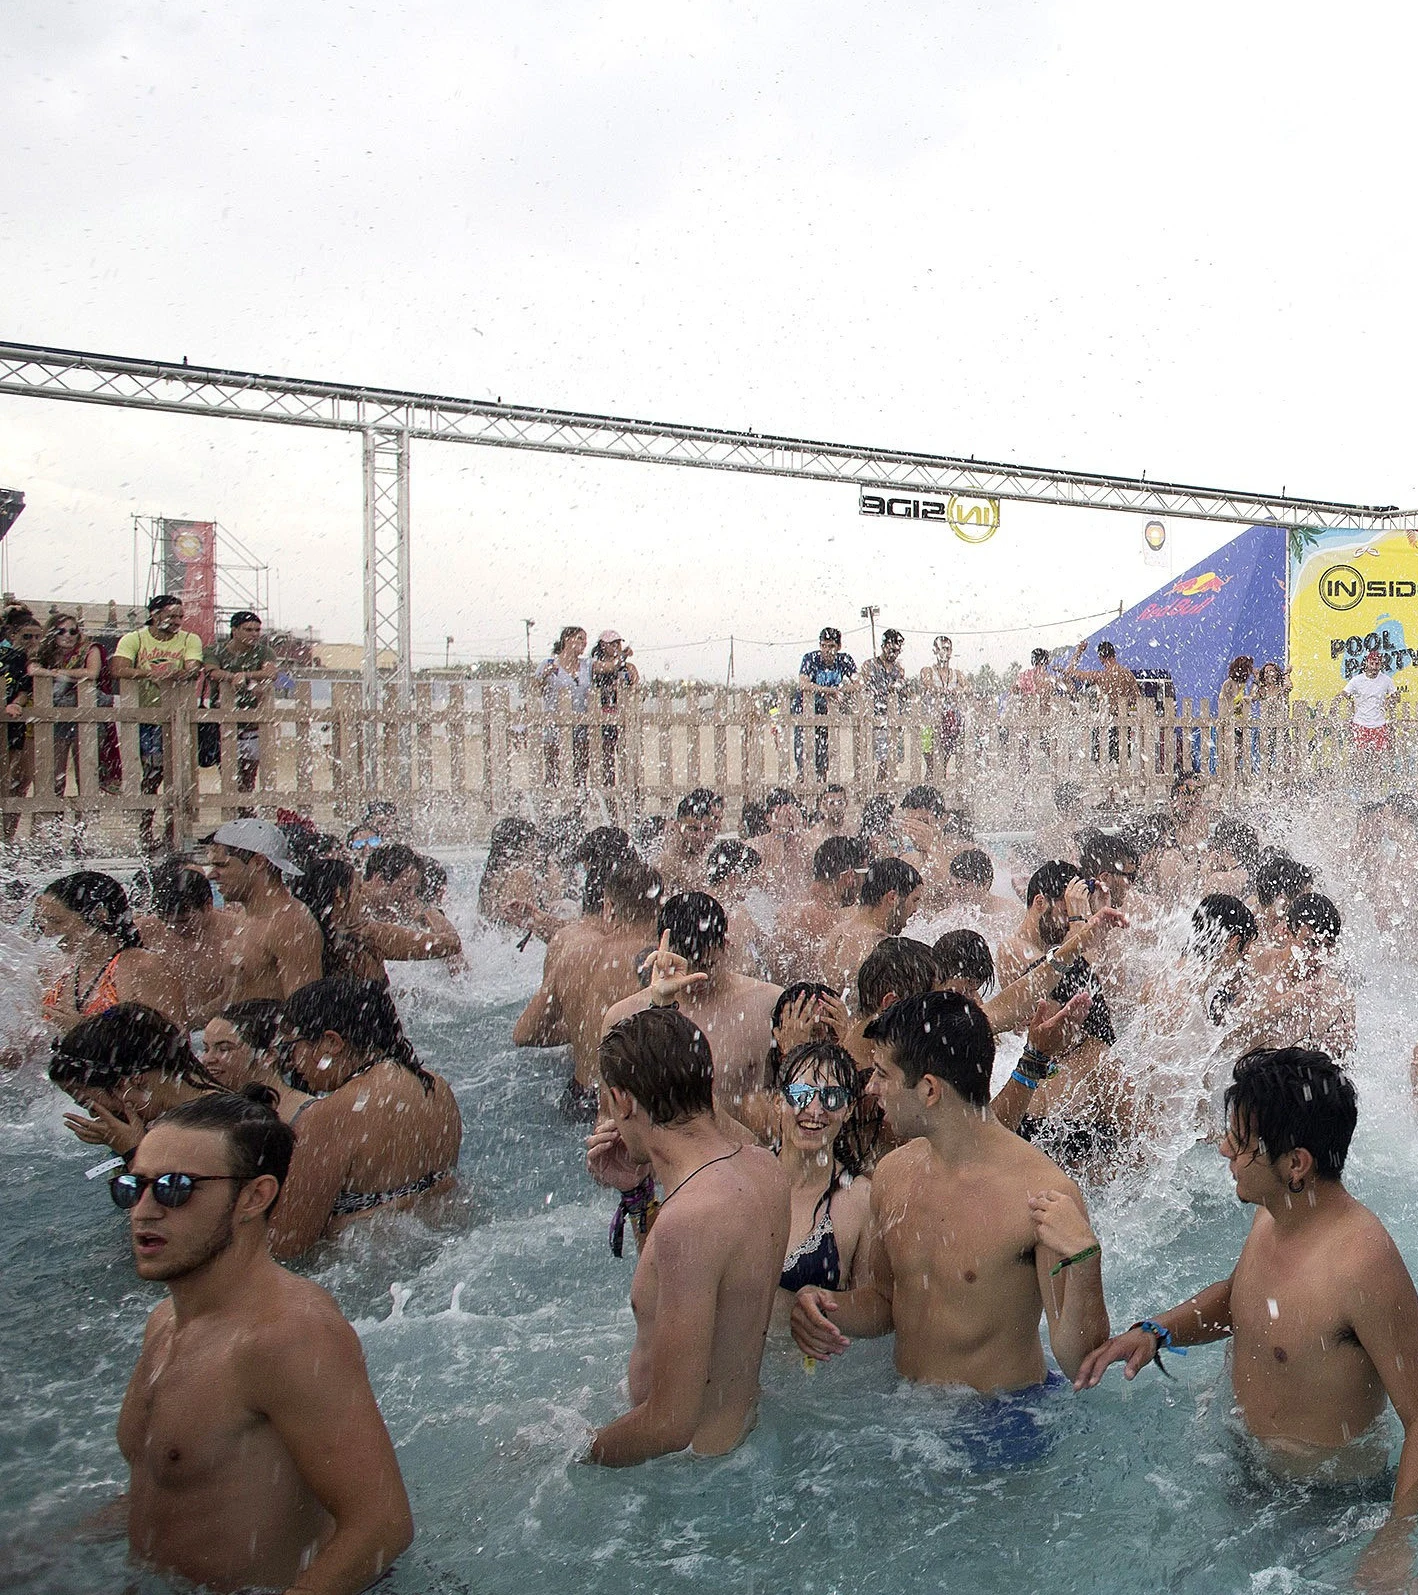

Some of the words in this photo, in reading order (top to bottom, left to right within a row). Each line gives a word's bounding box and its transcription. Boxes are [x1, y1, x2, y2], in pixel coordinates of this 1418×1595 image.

[1136, 600, 1174, 621] Red
[1172, 597, 1215, 616] Bull
[1331, 630, 1396, 659] POOL
